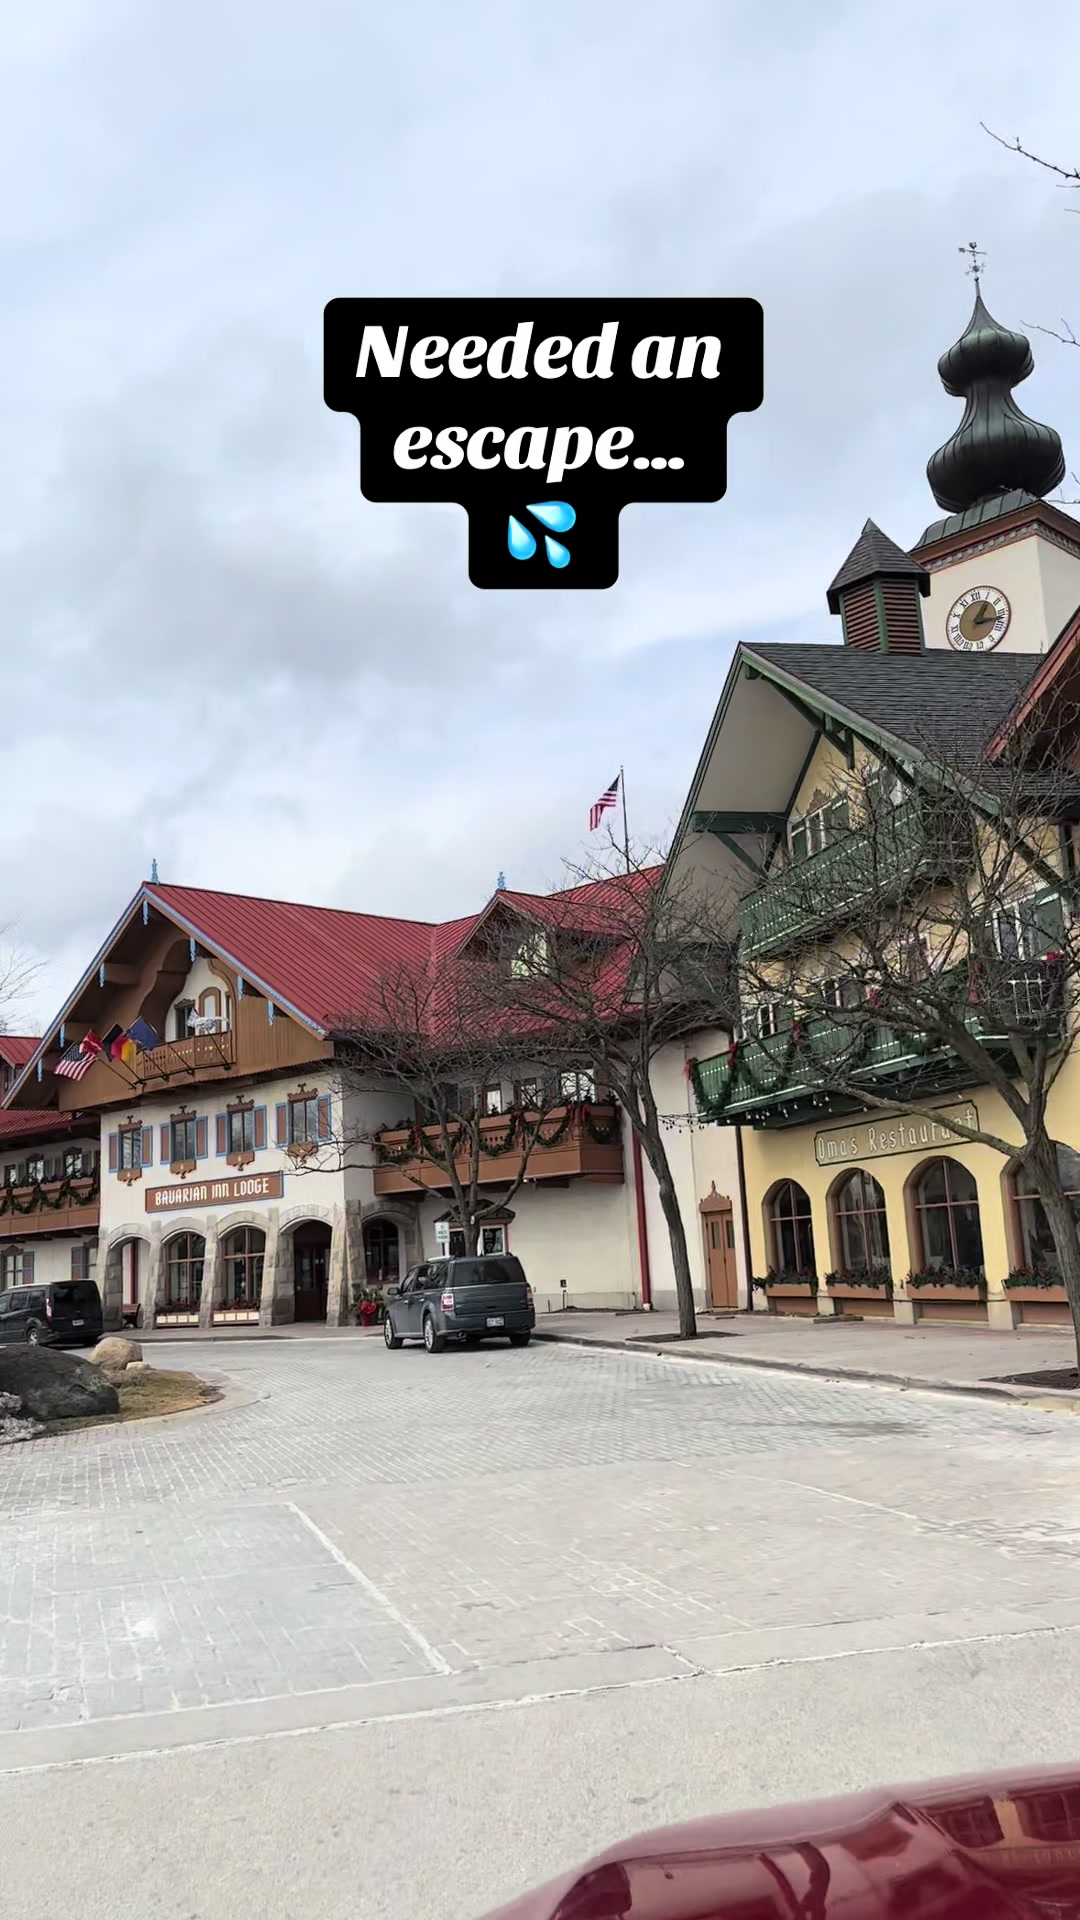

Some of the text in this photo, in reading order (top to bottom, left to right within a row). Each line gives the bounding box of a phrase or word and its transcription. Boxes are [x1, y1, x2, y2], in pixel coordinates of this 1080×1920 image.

[155, 1177, 269, 1206] BAVARIAN INN LODGE
